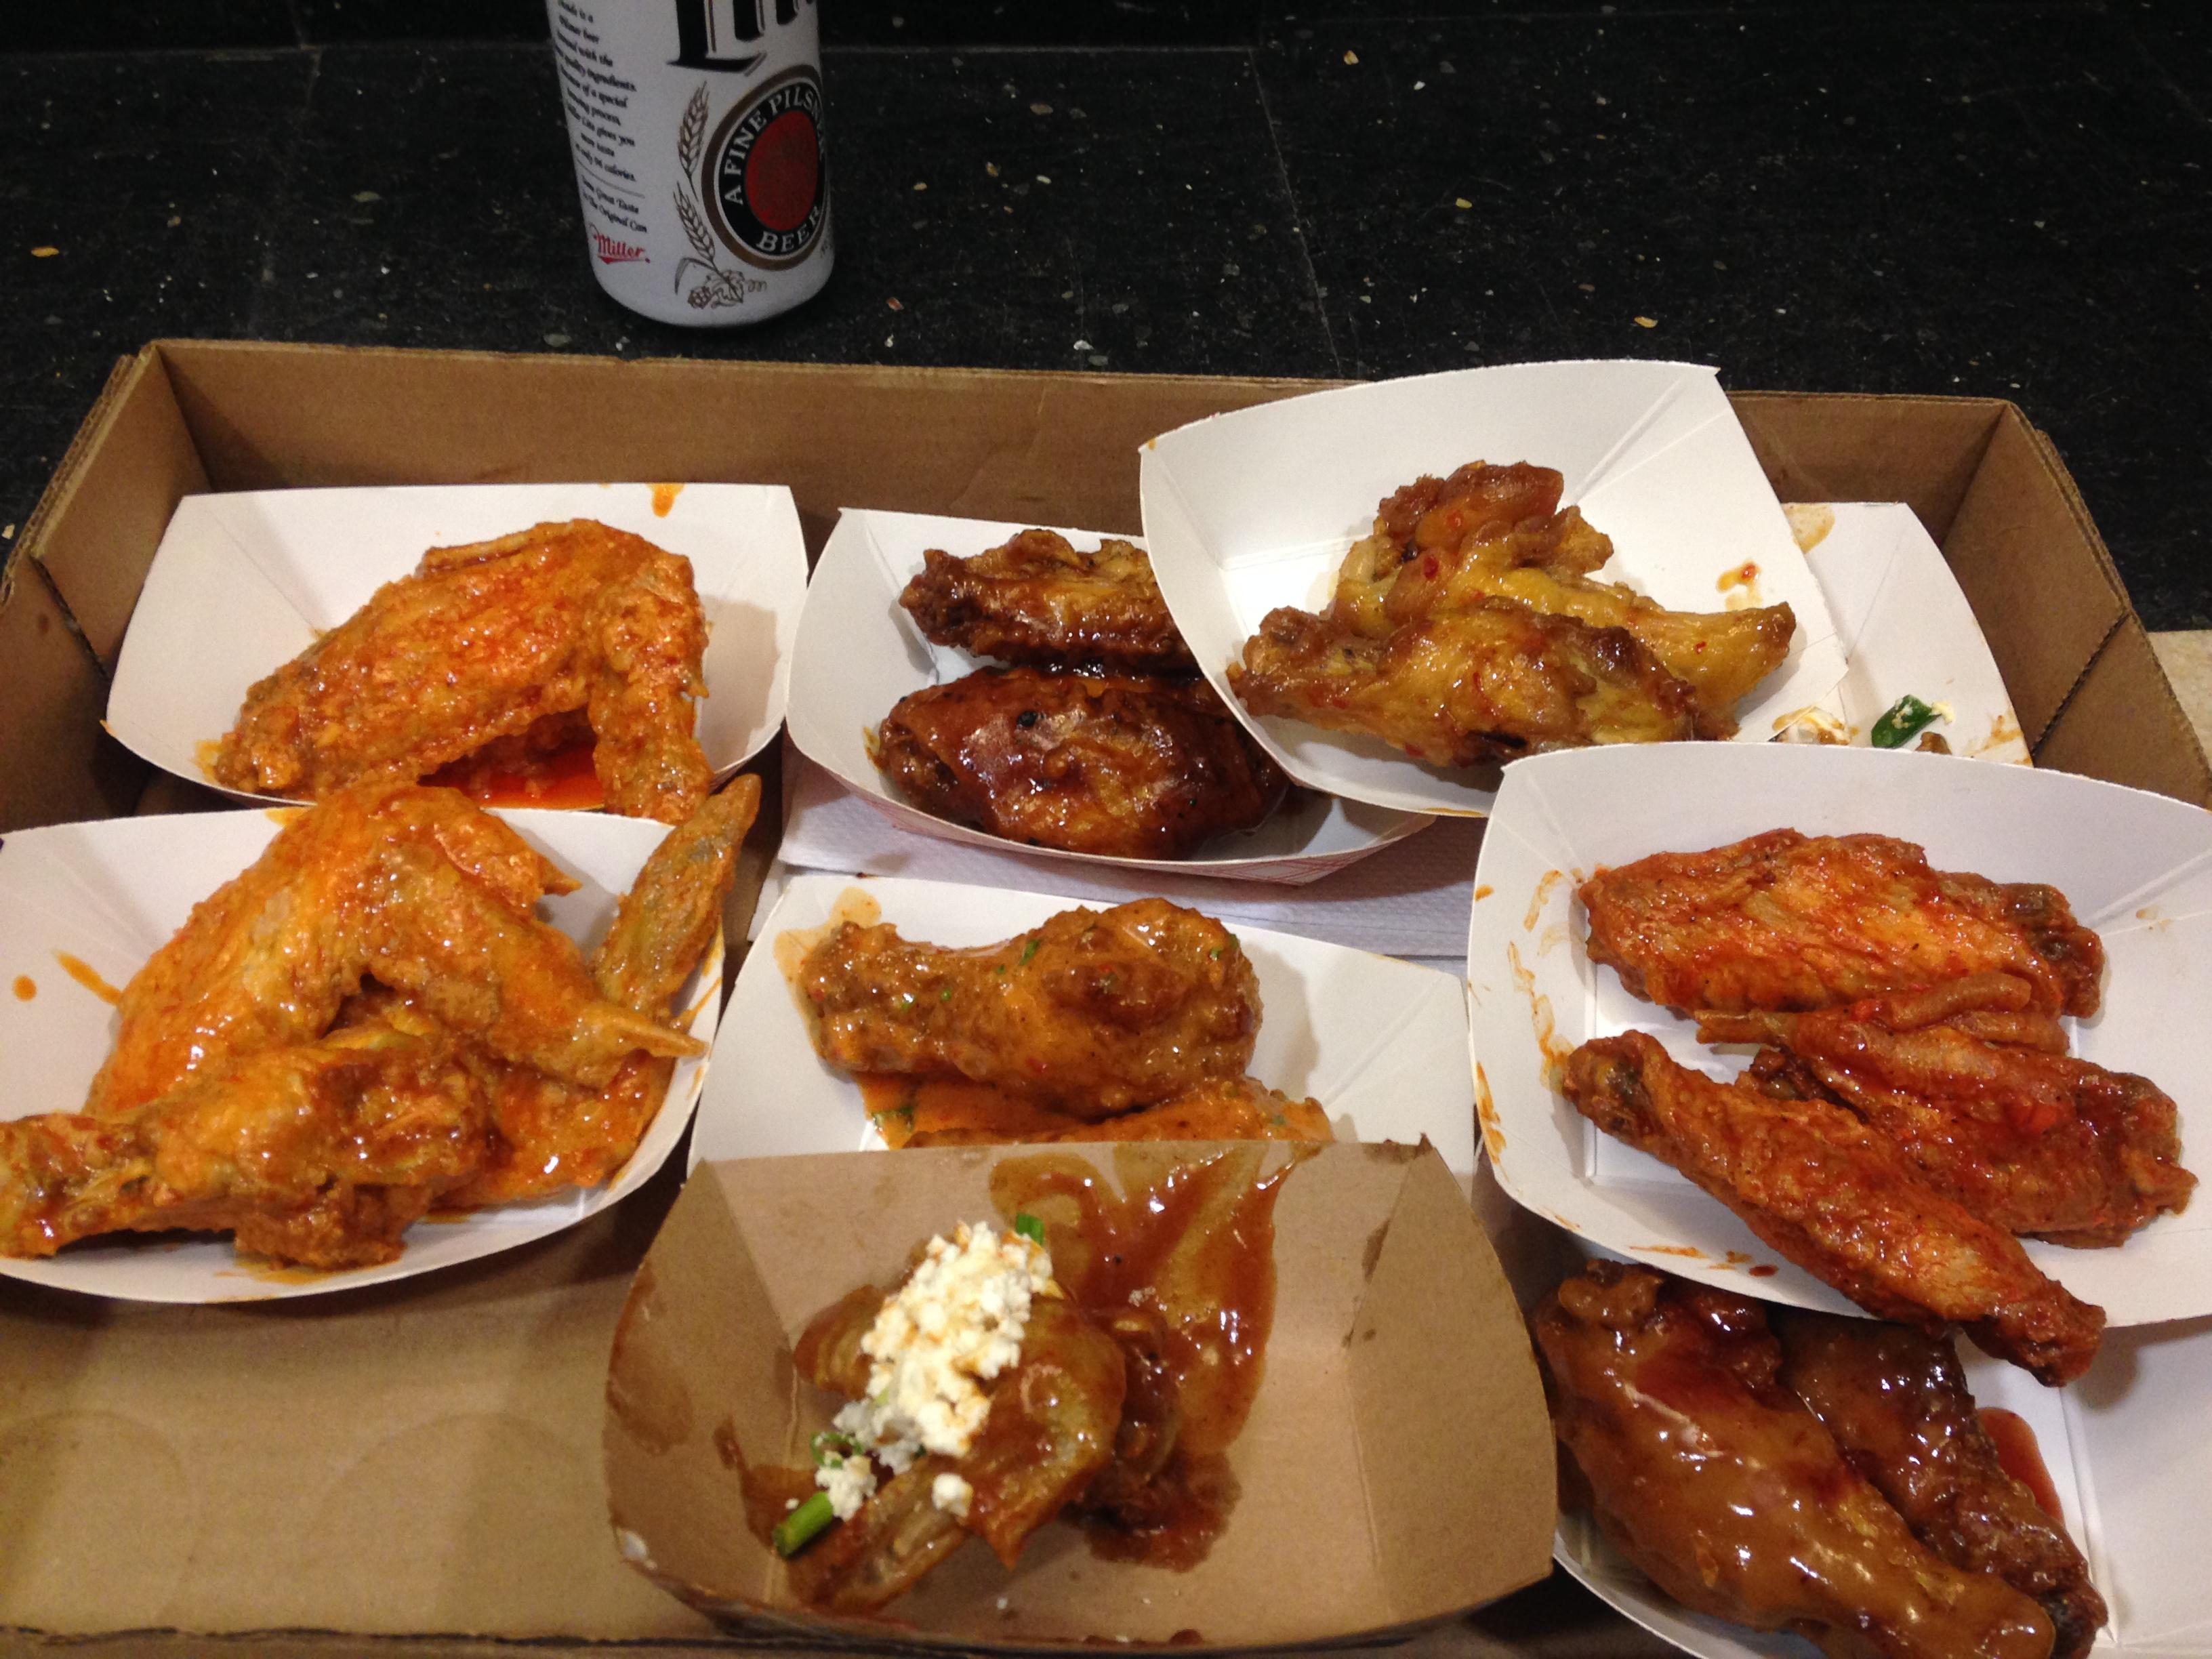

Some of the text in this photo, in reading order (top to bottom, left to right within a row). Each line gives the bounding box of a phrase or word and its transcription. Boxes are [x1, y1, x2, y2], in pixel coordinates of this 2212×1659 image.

[618, 135, 636, 147] you
[724, 110, 767, 176] FINE
[724, 184, 744, 205] A
[616, 198, 639, 214] Taste
[630, 220, 648, 233] Can
[756, 205, 821, 252] BEER
[590, 224, 647, 261] Miller
